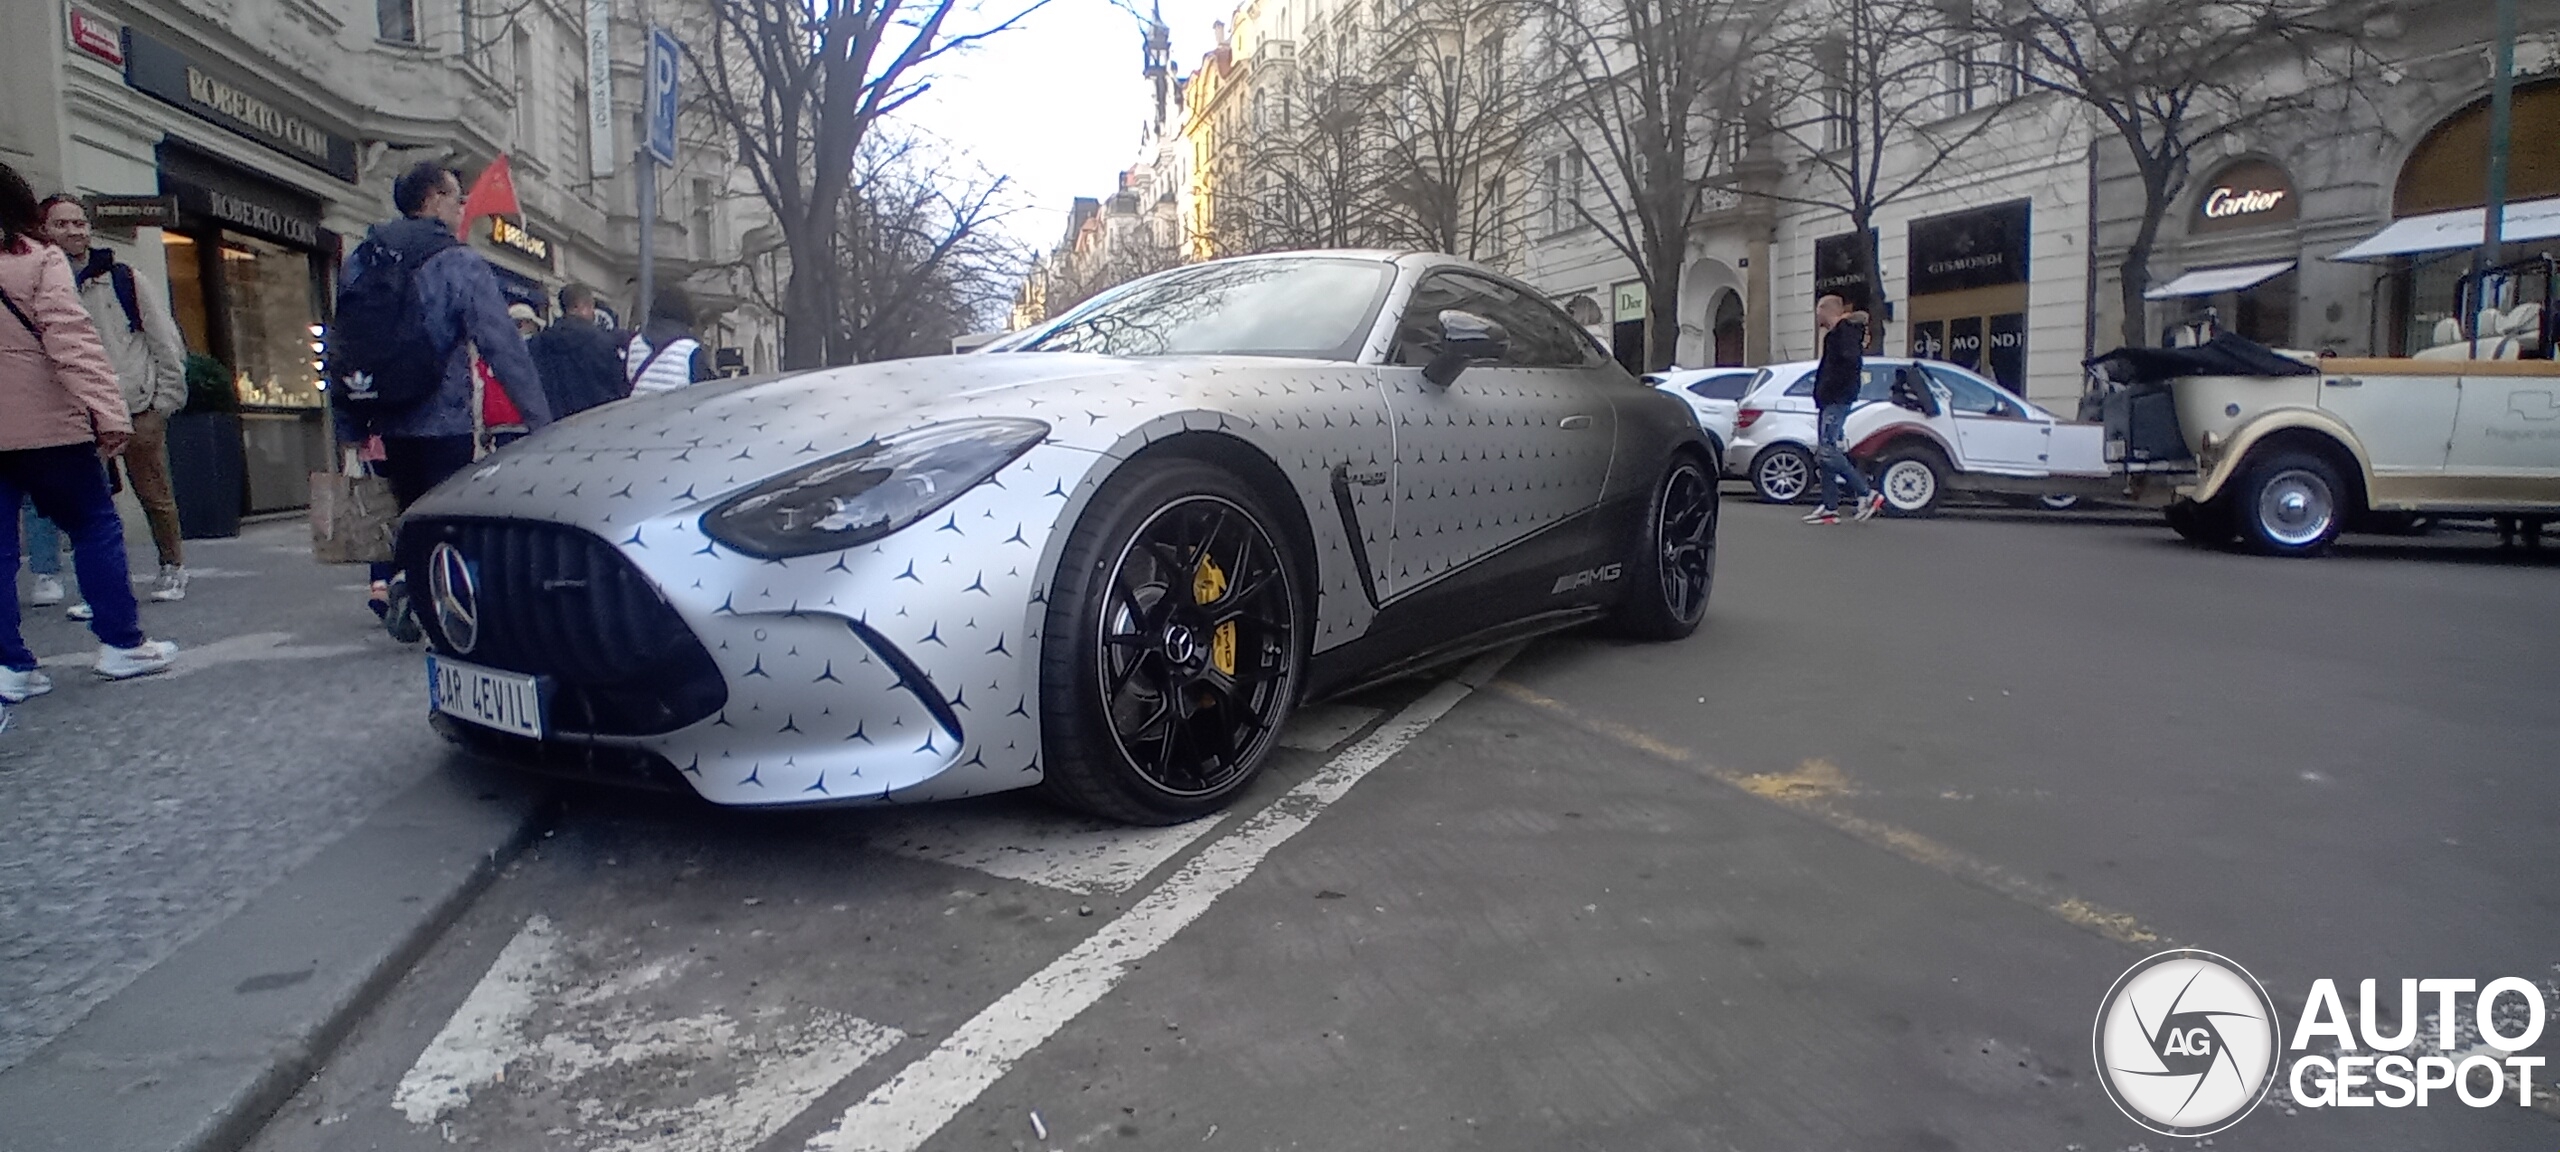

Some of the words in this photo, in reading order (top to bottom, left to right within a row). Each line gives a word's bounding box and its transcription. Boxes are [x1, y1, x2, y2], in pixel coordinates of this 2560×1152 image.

[656, 46, 673, 118] P
[187, 66, 283, 138] ROBERTO
[210, 190, 281, 235] ROBERTO
[2205, 186, 2286, 218] Cartier
[1928, 251, 2003, 274] GISMONDI
[1621, 293, 1643, 311] Dior
[1573, 561, 1622, 590] AMG
[434, 664, 463, 713] CAR
[472, 673, 533, 730] 4EVIL
